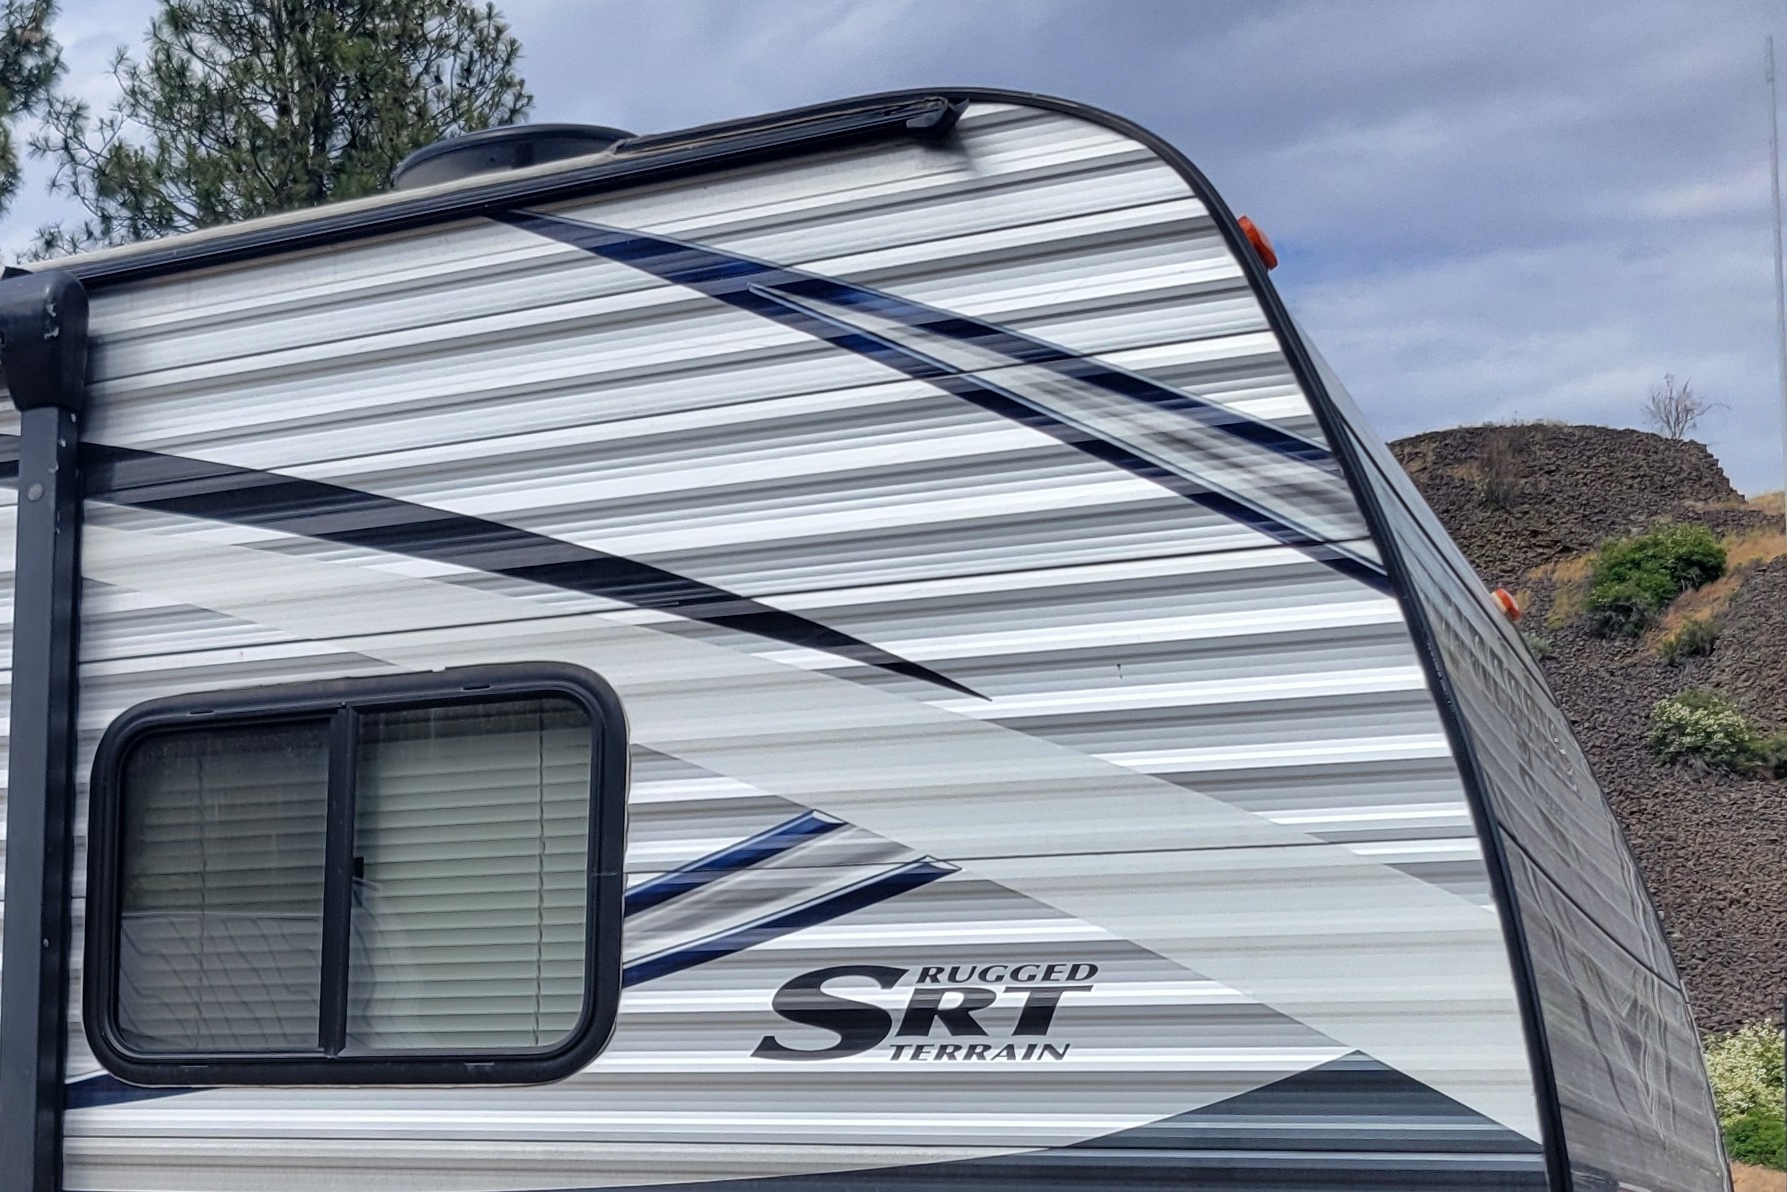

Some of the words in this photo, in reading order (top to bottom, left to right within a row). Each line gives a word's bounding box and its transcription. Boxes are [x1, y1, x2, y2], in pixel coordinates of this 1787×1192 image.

[915, 962, 1100, 985] RUGGED
[750, 964, 1094, 1062] SRT
[889, 1043, 1072, 1062] TERRAIN
